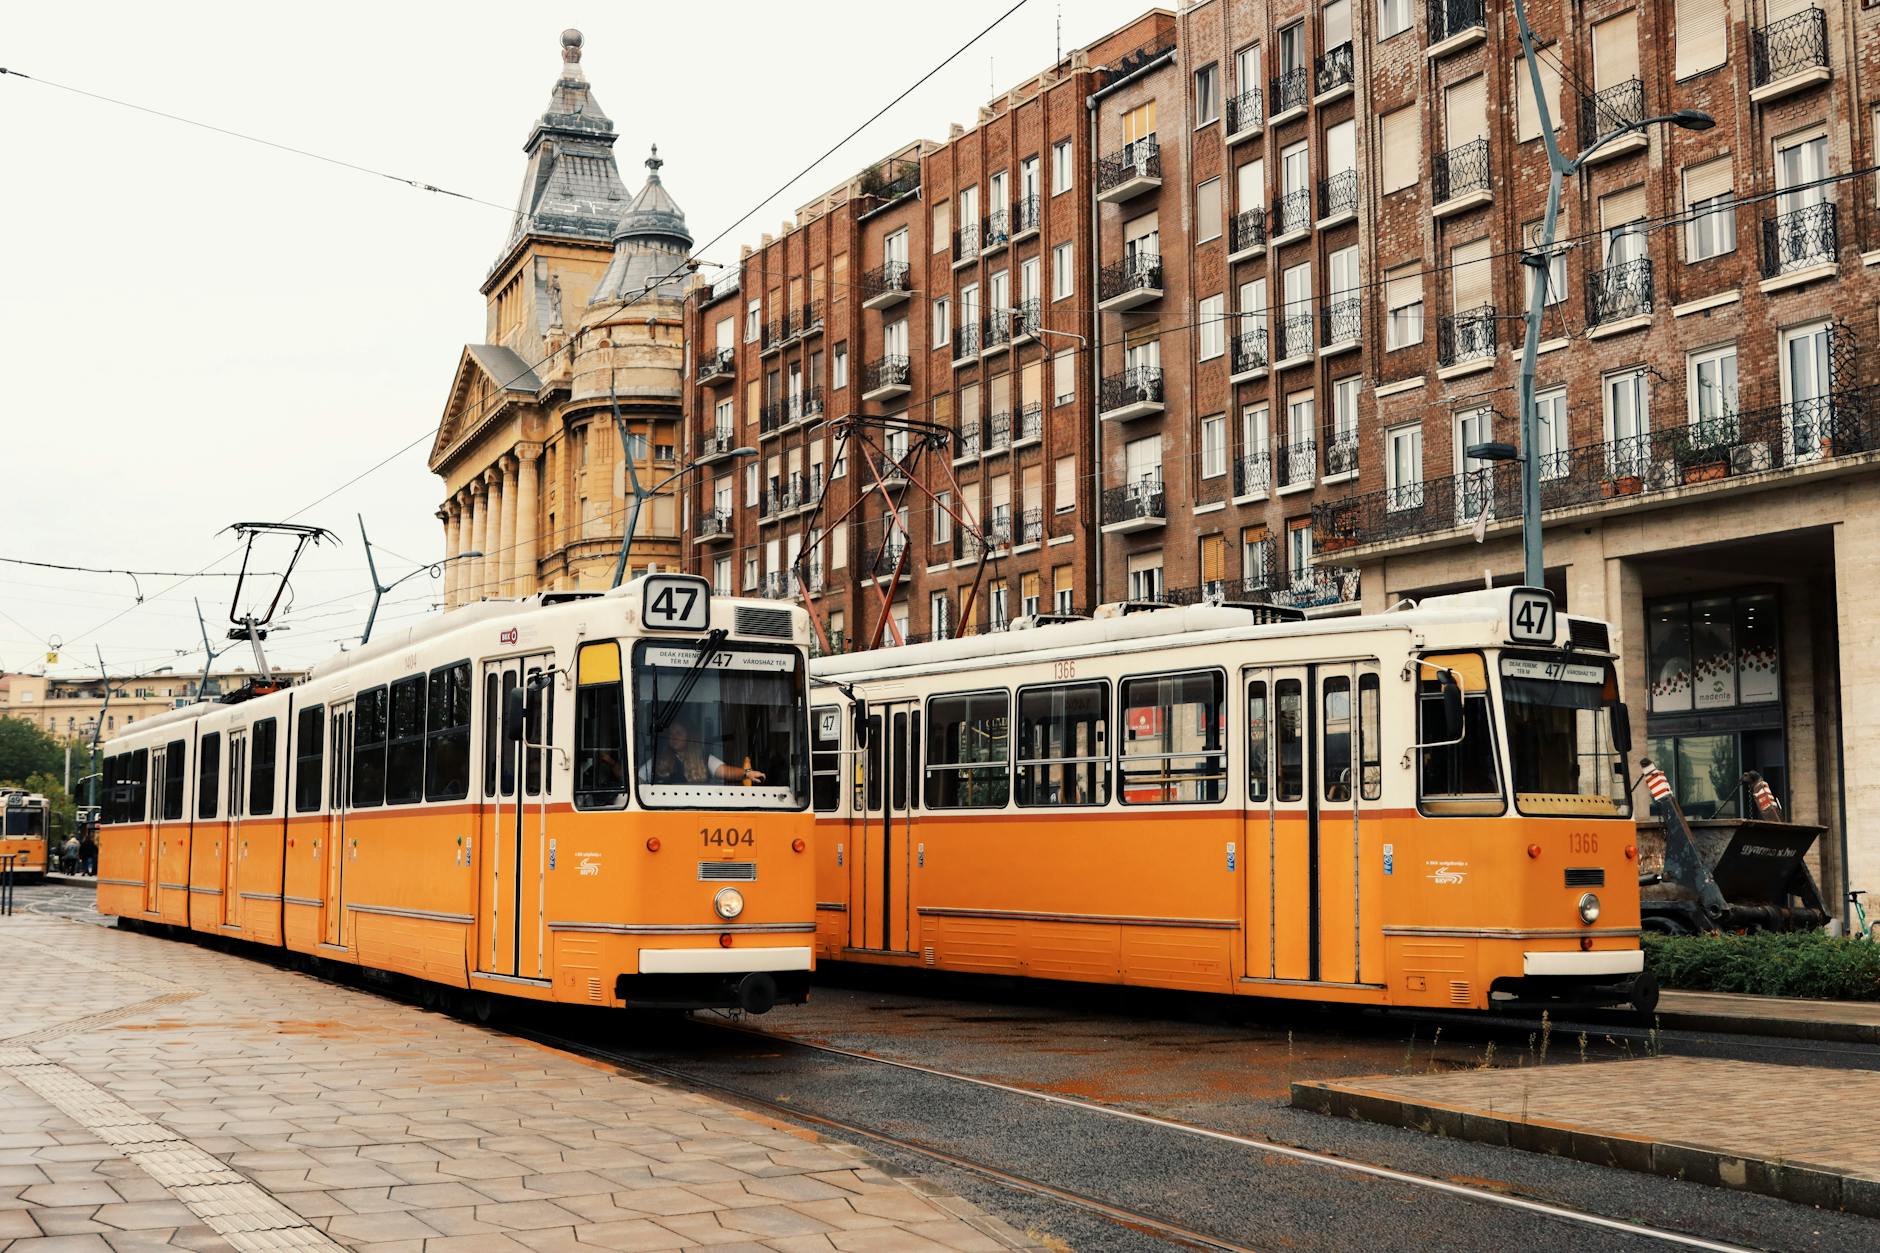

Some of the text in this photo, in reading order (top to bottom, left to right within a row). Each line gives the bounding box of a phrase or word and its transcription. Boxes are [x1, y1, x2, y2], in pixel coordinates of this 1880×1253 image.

[651, 587, 698, 621] 47
[1516, 600, 1549, 634] 47
[712, 653, 733, 667] 47
[743, 658, 774, 666] VÁROSHÁZ
[1054, 660, 1076, 681] 1366
[1545, 663, 1560, 678] 47
[822, 715, 835, 731] 47
[700, 828, 755, 847] 1404
[1569, 832, 1599, 854] 1366
